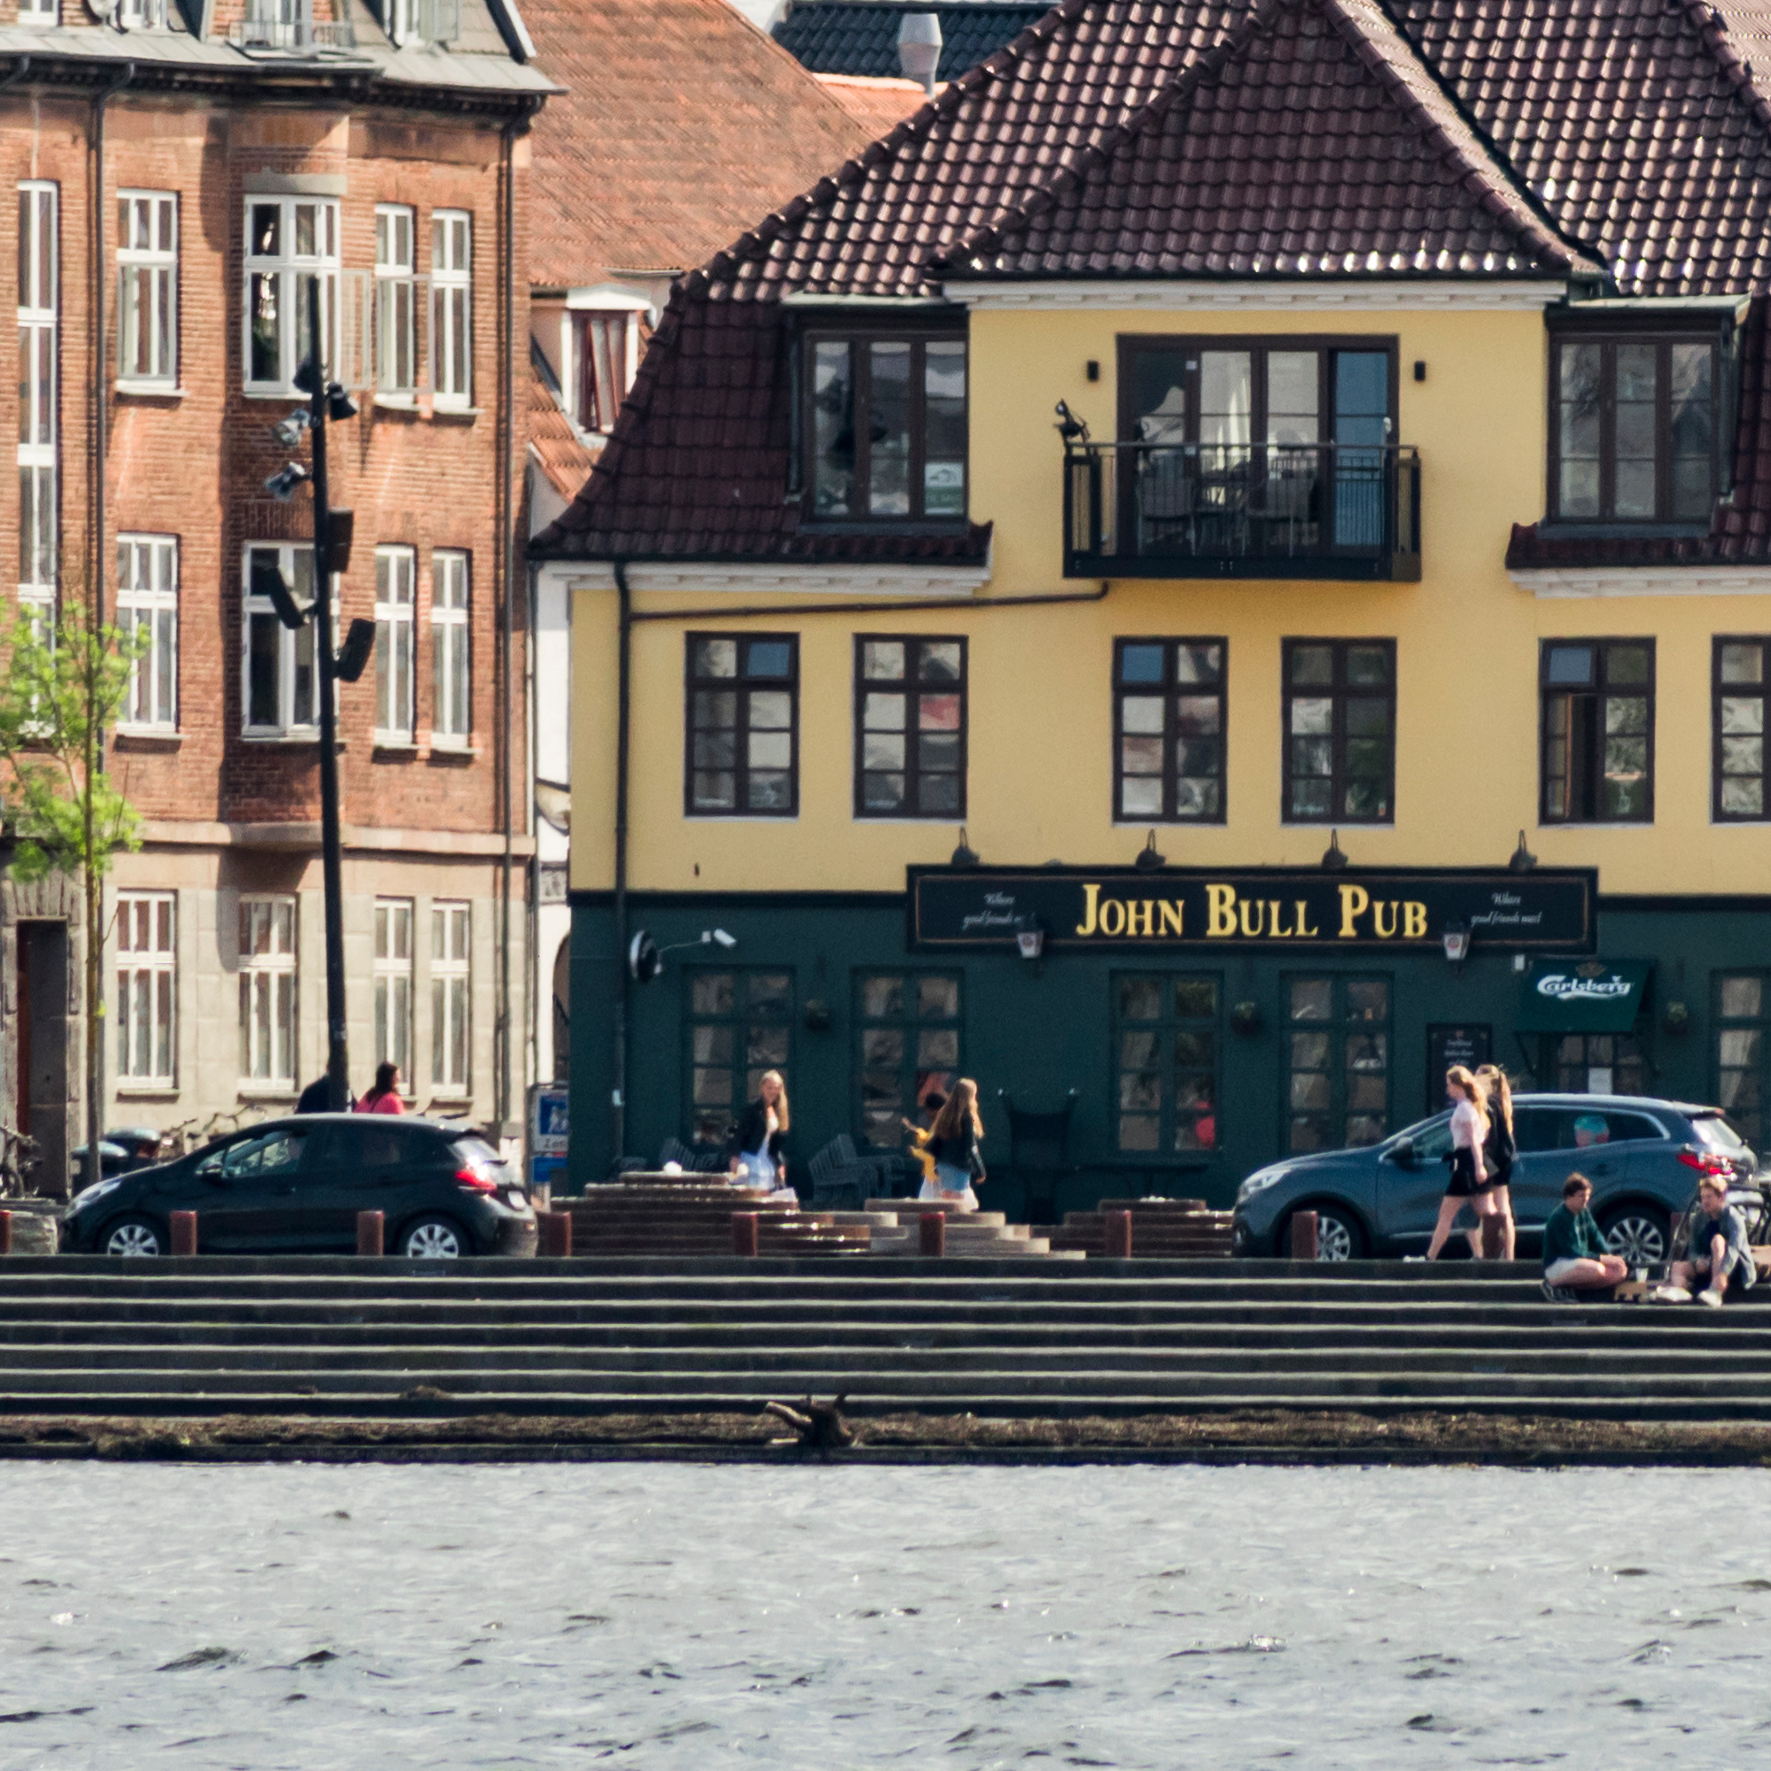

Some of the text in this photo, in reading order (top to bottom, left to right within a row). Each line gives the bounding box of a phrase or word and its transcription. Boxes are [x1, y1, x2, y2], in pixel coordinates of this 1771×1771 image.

[1077, 884, 1428, 937] JOHN BULL PUB
[1537, 974, 1633, 1000] Carlsberg
